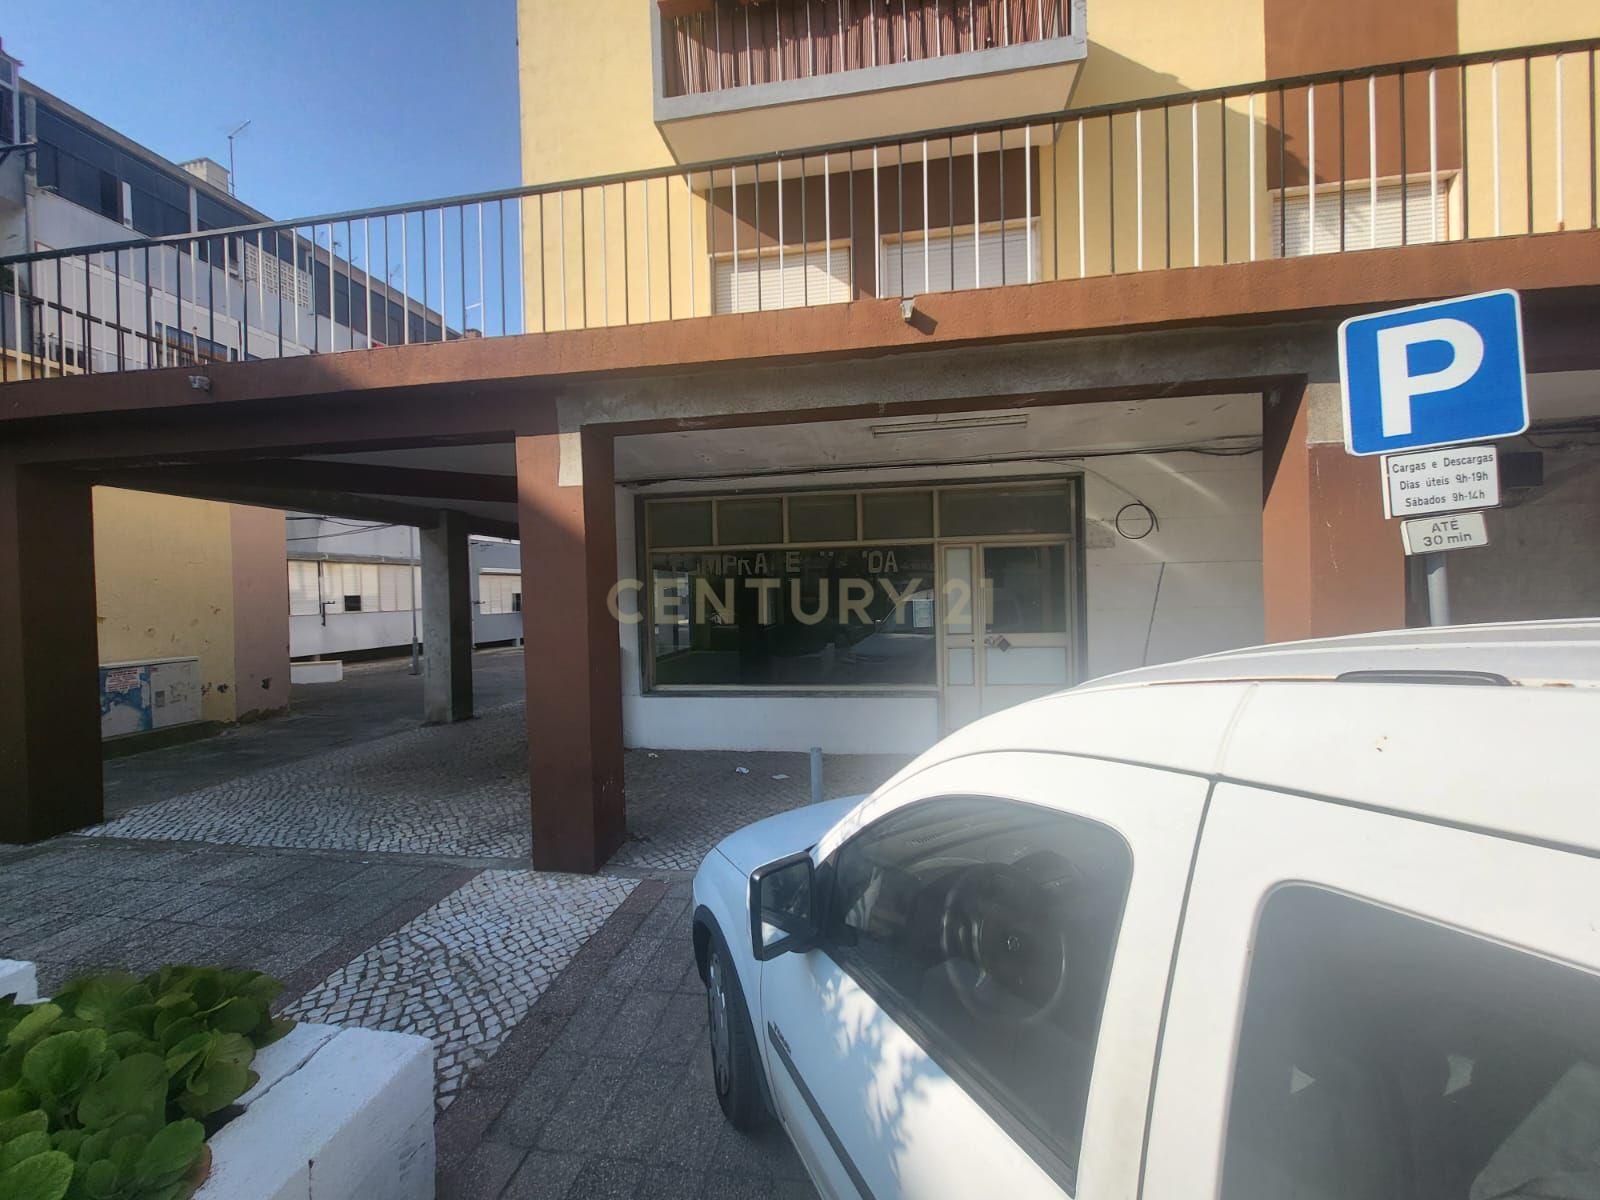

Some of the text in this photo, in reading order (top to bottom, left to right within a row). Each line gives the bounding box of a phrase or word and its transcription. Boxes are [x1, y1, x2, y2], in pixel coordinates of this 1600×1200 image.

[1377, 318, 1484, 438] P
[1392, 462, 1426, 473] Cargas
[1443, 454, 1494, 467] Descargas
[1400, 471, 1488, 490] Dias úteis 9h-19h
[1452, 490, 1485, 501] 9h-14h
[1431, 520, 1459, 533] ATÉ
[1423, 533, 1472, 547] 30 min
